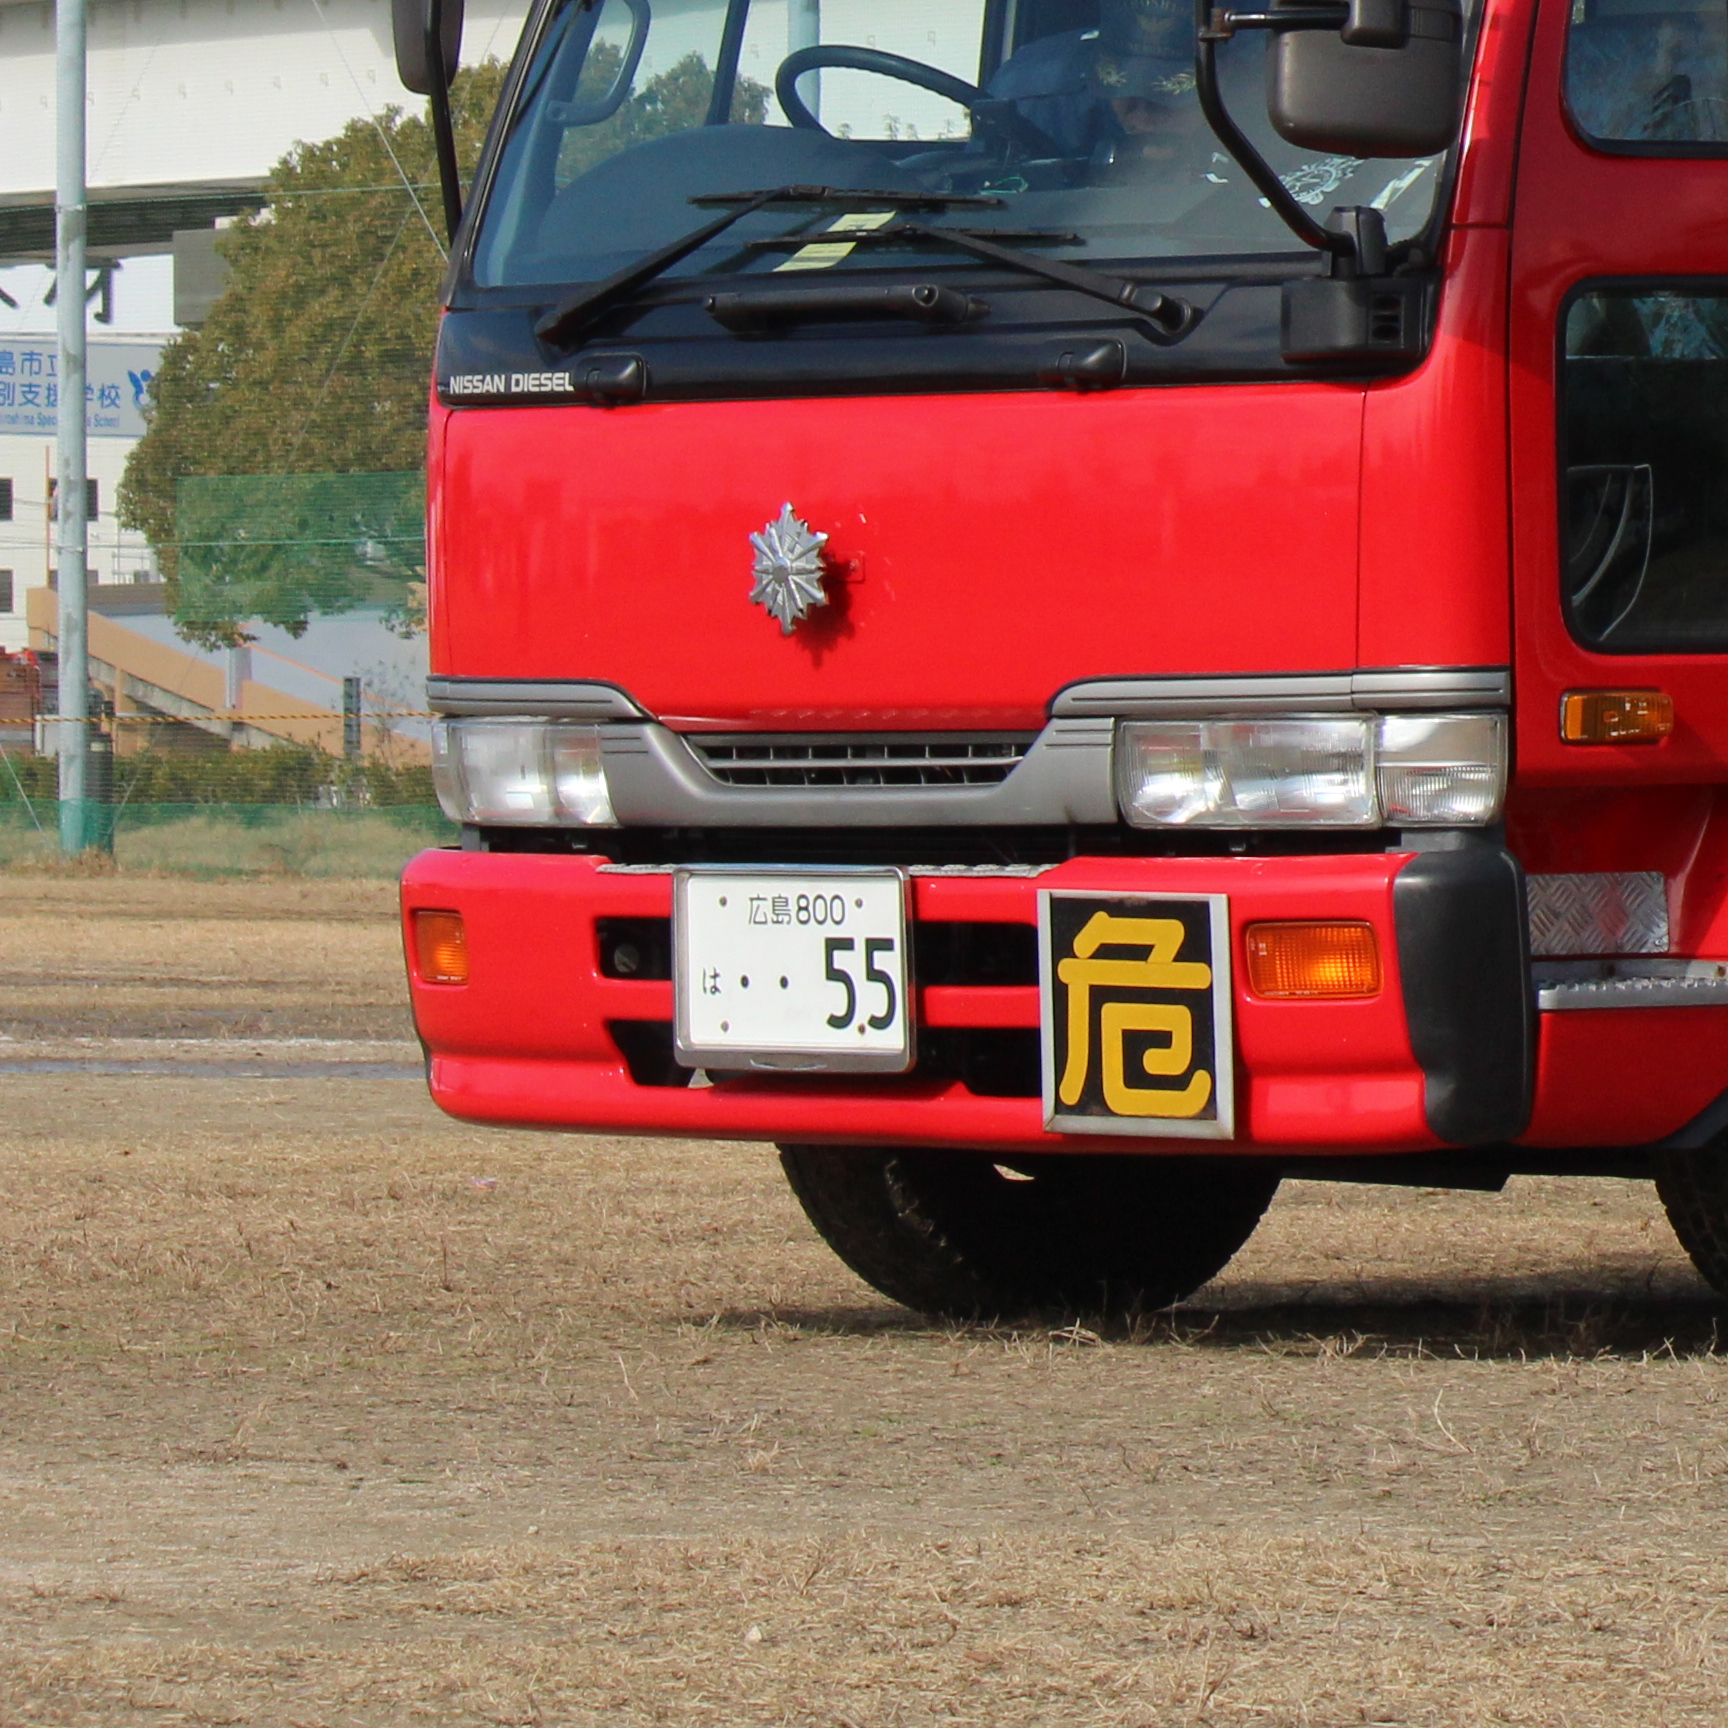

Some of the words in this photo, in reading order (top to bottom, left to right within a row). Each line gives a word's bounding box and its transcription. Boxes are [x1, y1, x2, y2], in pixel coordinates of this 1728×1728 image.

[449, 373, 506, 394] NISSAN
[511, 372, 575, 393] DIESEL
[1056, 909, 1213, 1119] 危
